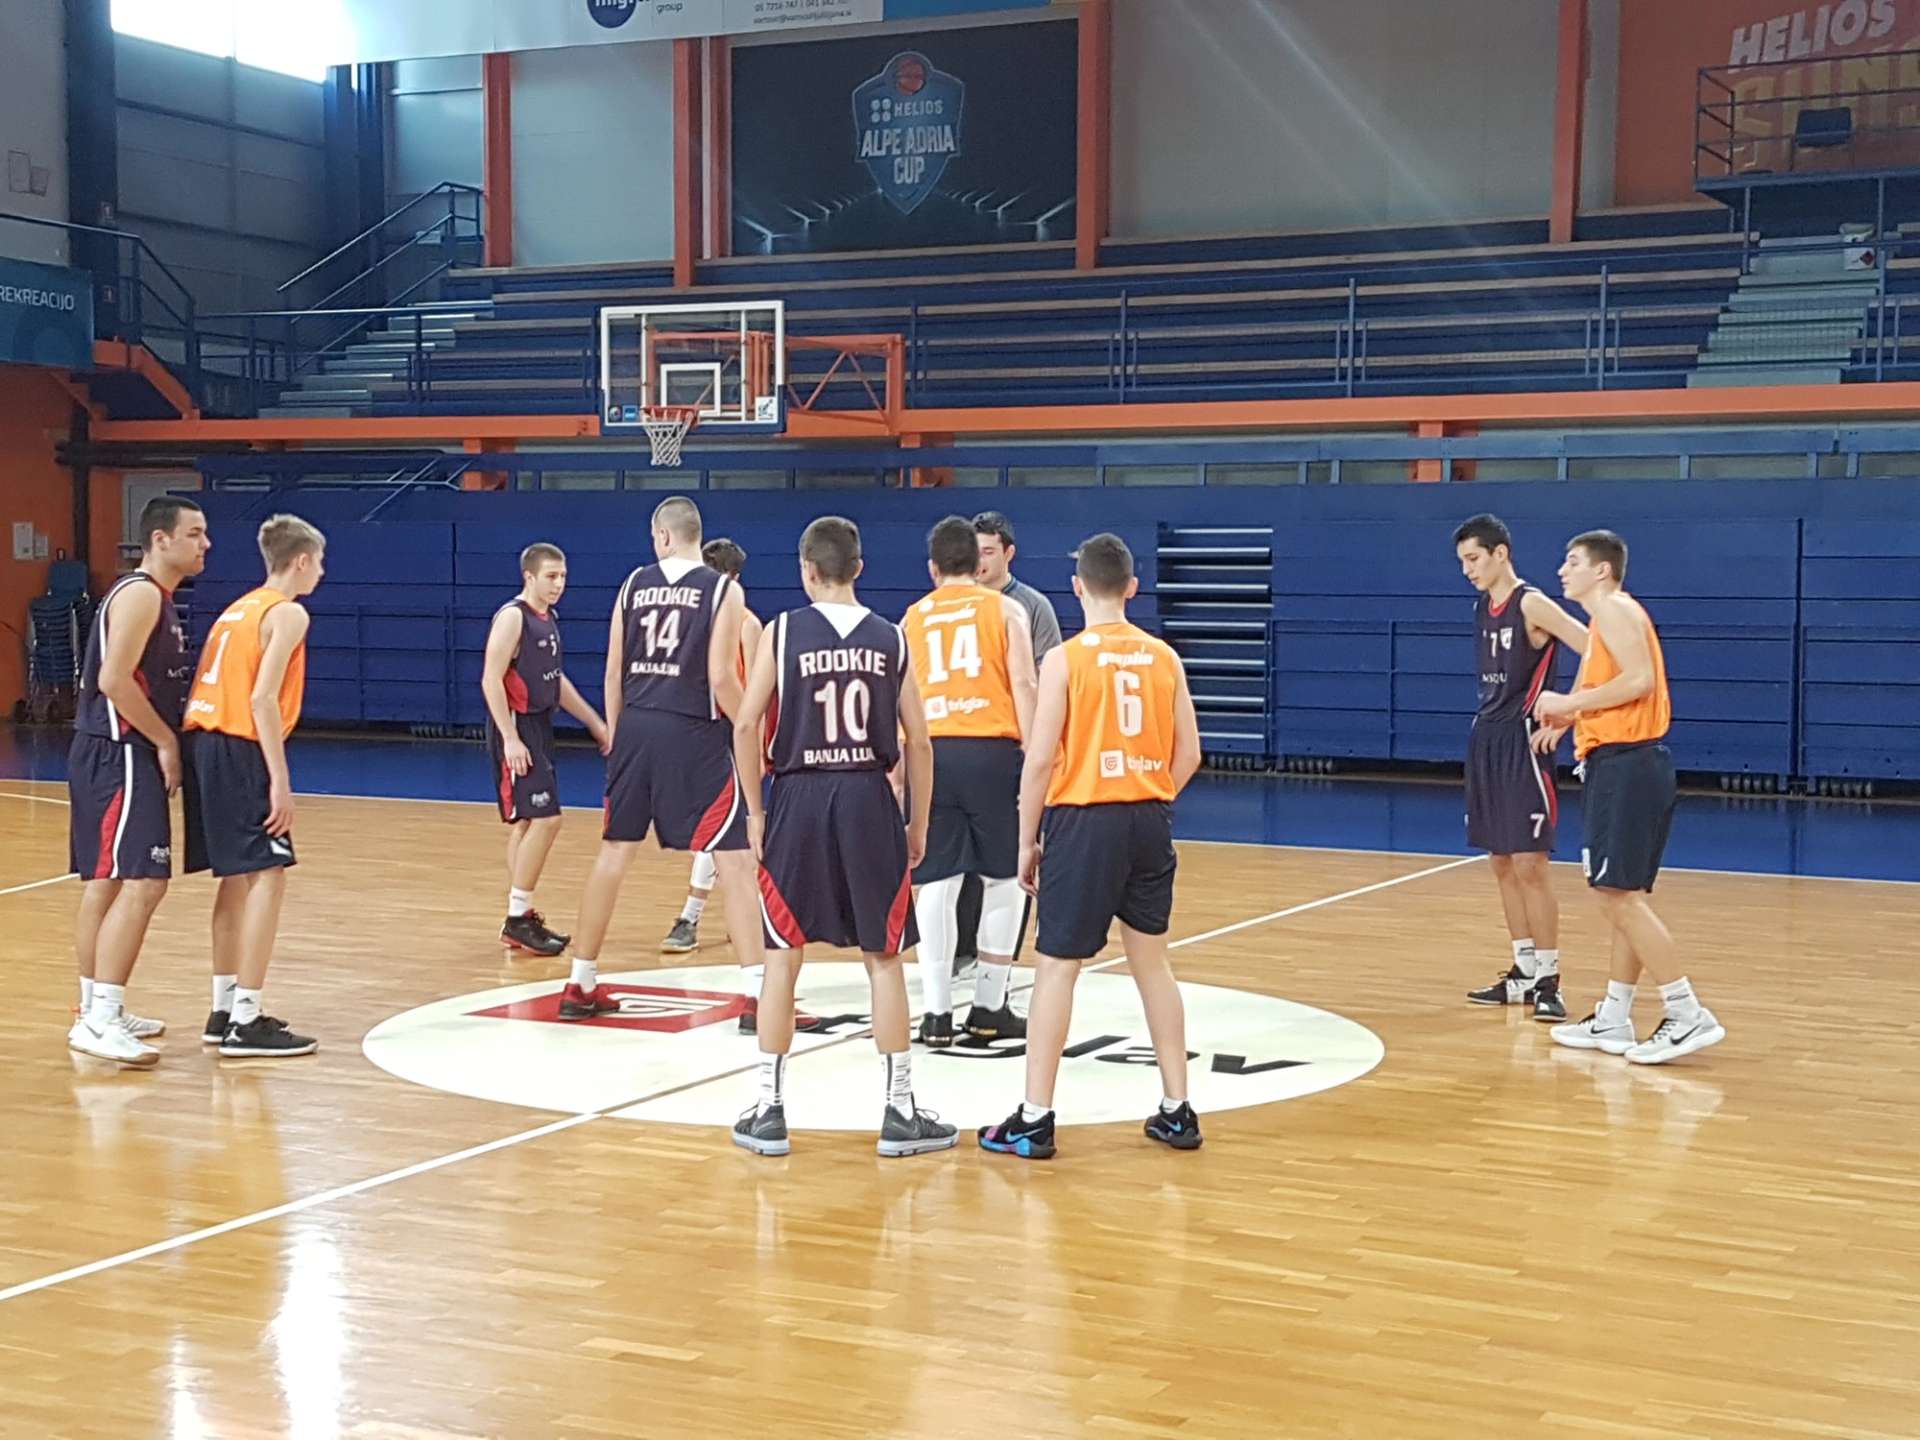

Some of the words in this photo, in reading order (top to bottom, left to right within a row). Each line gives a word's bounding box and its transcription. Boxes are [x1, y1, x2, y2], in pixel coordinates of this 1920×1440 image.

[1727, 0, 1896, 74] HELIOS
[894, 100, 944, 117] HELIOS
[861, 129, 902, 157] ALPE
[905, 125, 955, 154] ADRIA
[894, 156, 925, 184] CUP
[633, 586, 702, 610] ROOKIE
[640, 609, 680, 658] 14
[799, 648, 886, 677] ROOKIE
[925, 623, 983, 685] 14
[814, 678, 870, 743] 10
[1113, 670, 1142, 737] 6
[804, 748, 850, 764] BANJA
[1530, 813, 1545, 838] 7
